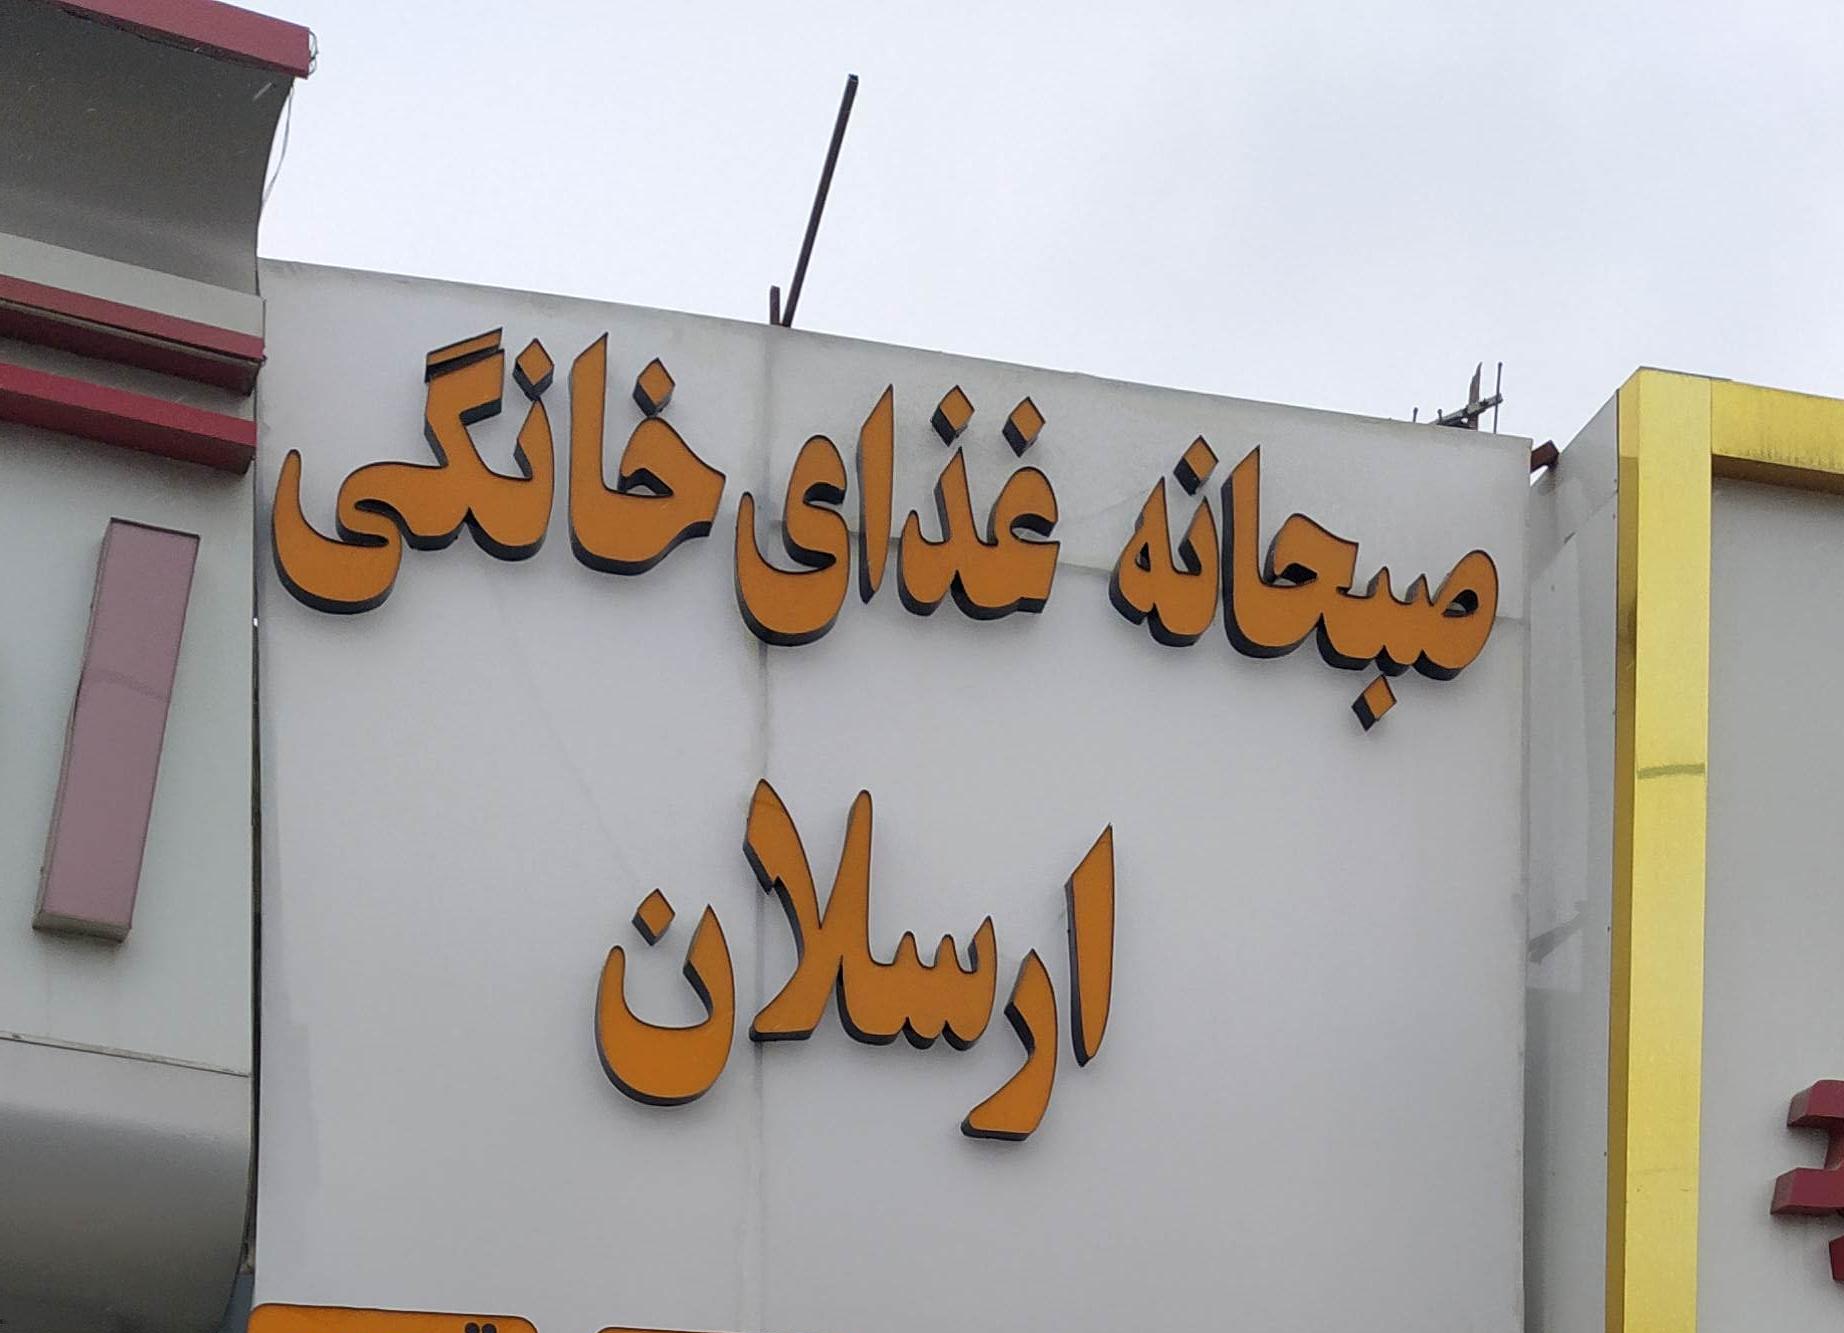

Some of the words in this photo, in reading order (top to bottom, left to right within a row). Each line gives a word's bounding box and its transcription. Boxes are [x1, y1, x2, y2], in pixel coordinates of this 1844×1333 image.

[271, 327, 725, 614] خانگی
[735, 383, 1062, 646] غذای
[1109, 434, 1498, 731] صبحانه
[595, 778, 1114, 1141] ارسلان
